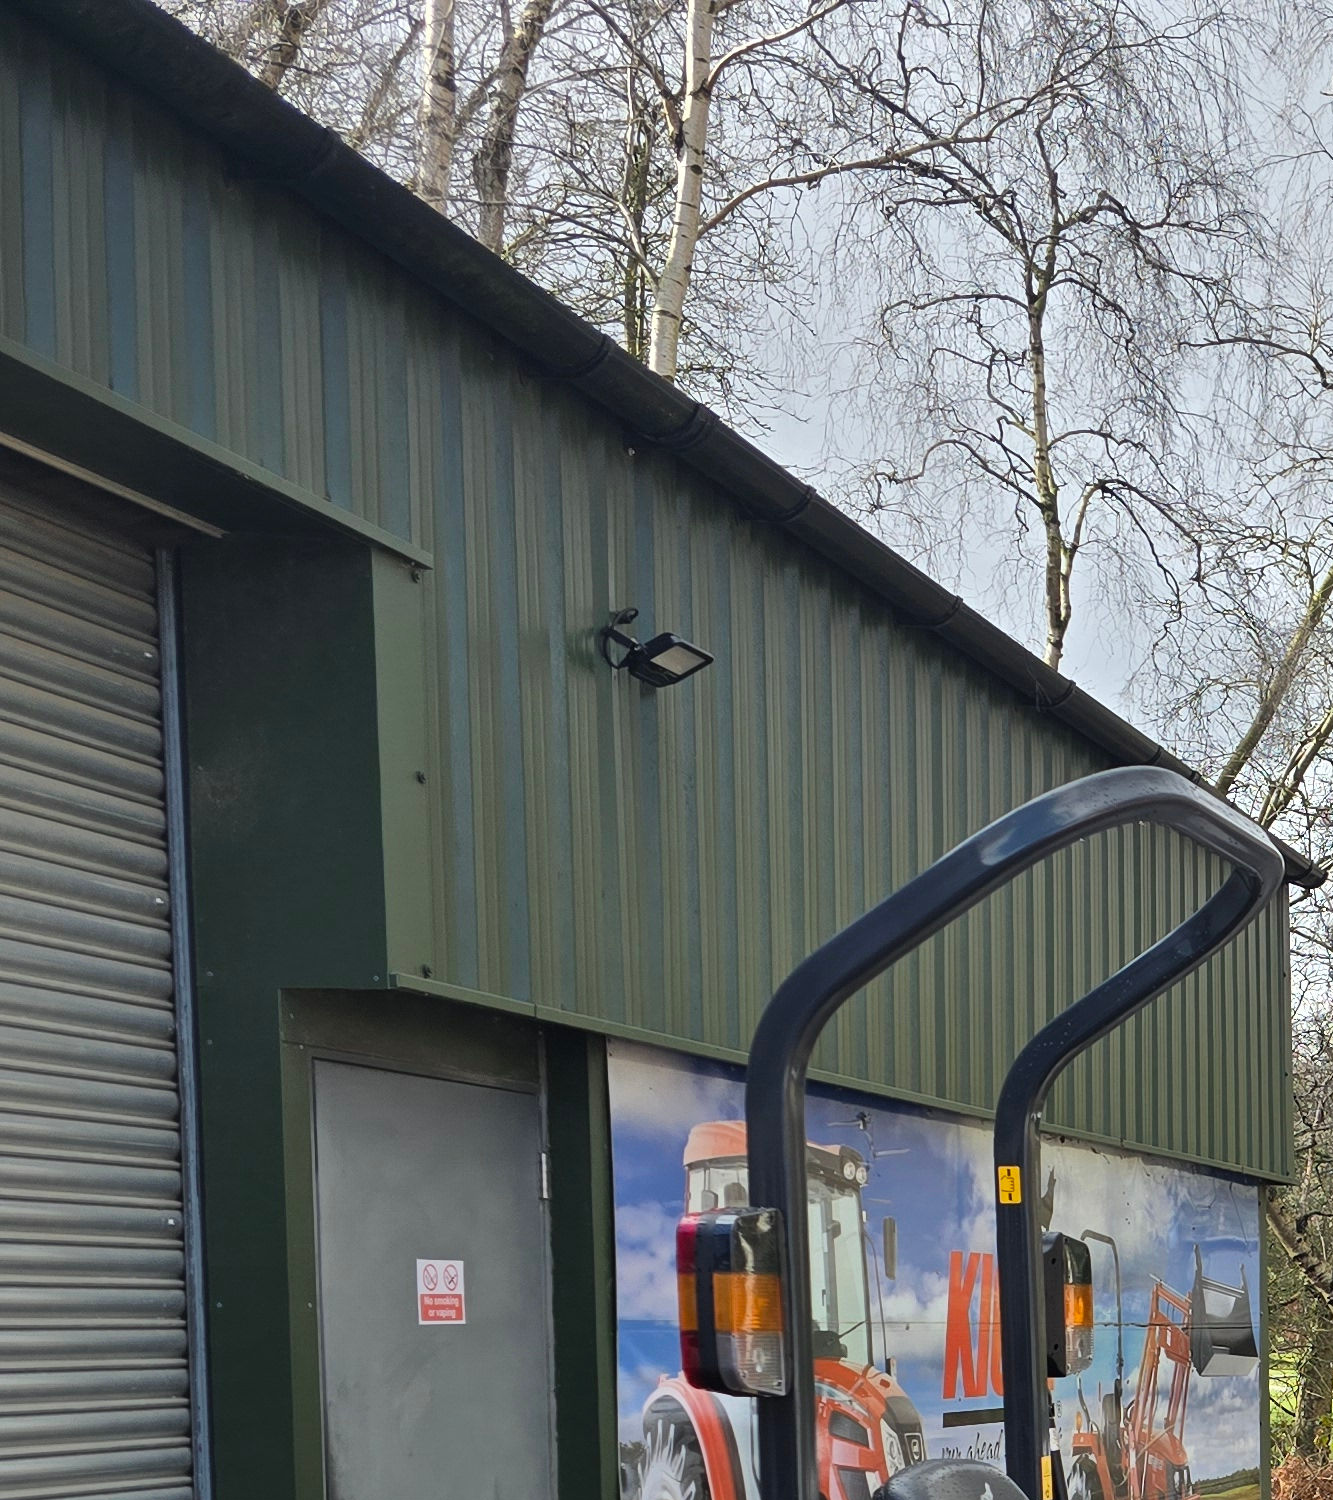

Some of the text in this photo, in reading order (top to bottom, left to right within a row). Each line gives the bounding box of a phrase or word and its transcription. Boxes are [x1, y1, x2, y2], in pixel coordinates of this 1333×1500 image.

[423, 1295, 459, 1307] No smoking
[436, 1307, 456, 1319] vaping
[967, 1429, 1004, 1461] ahead
